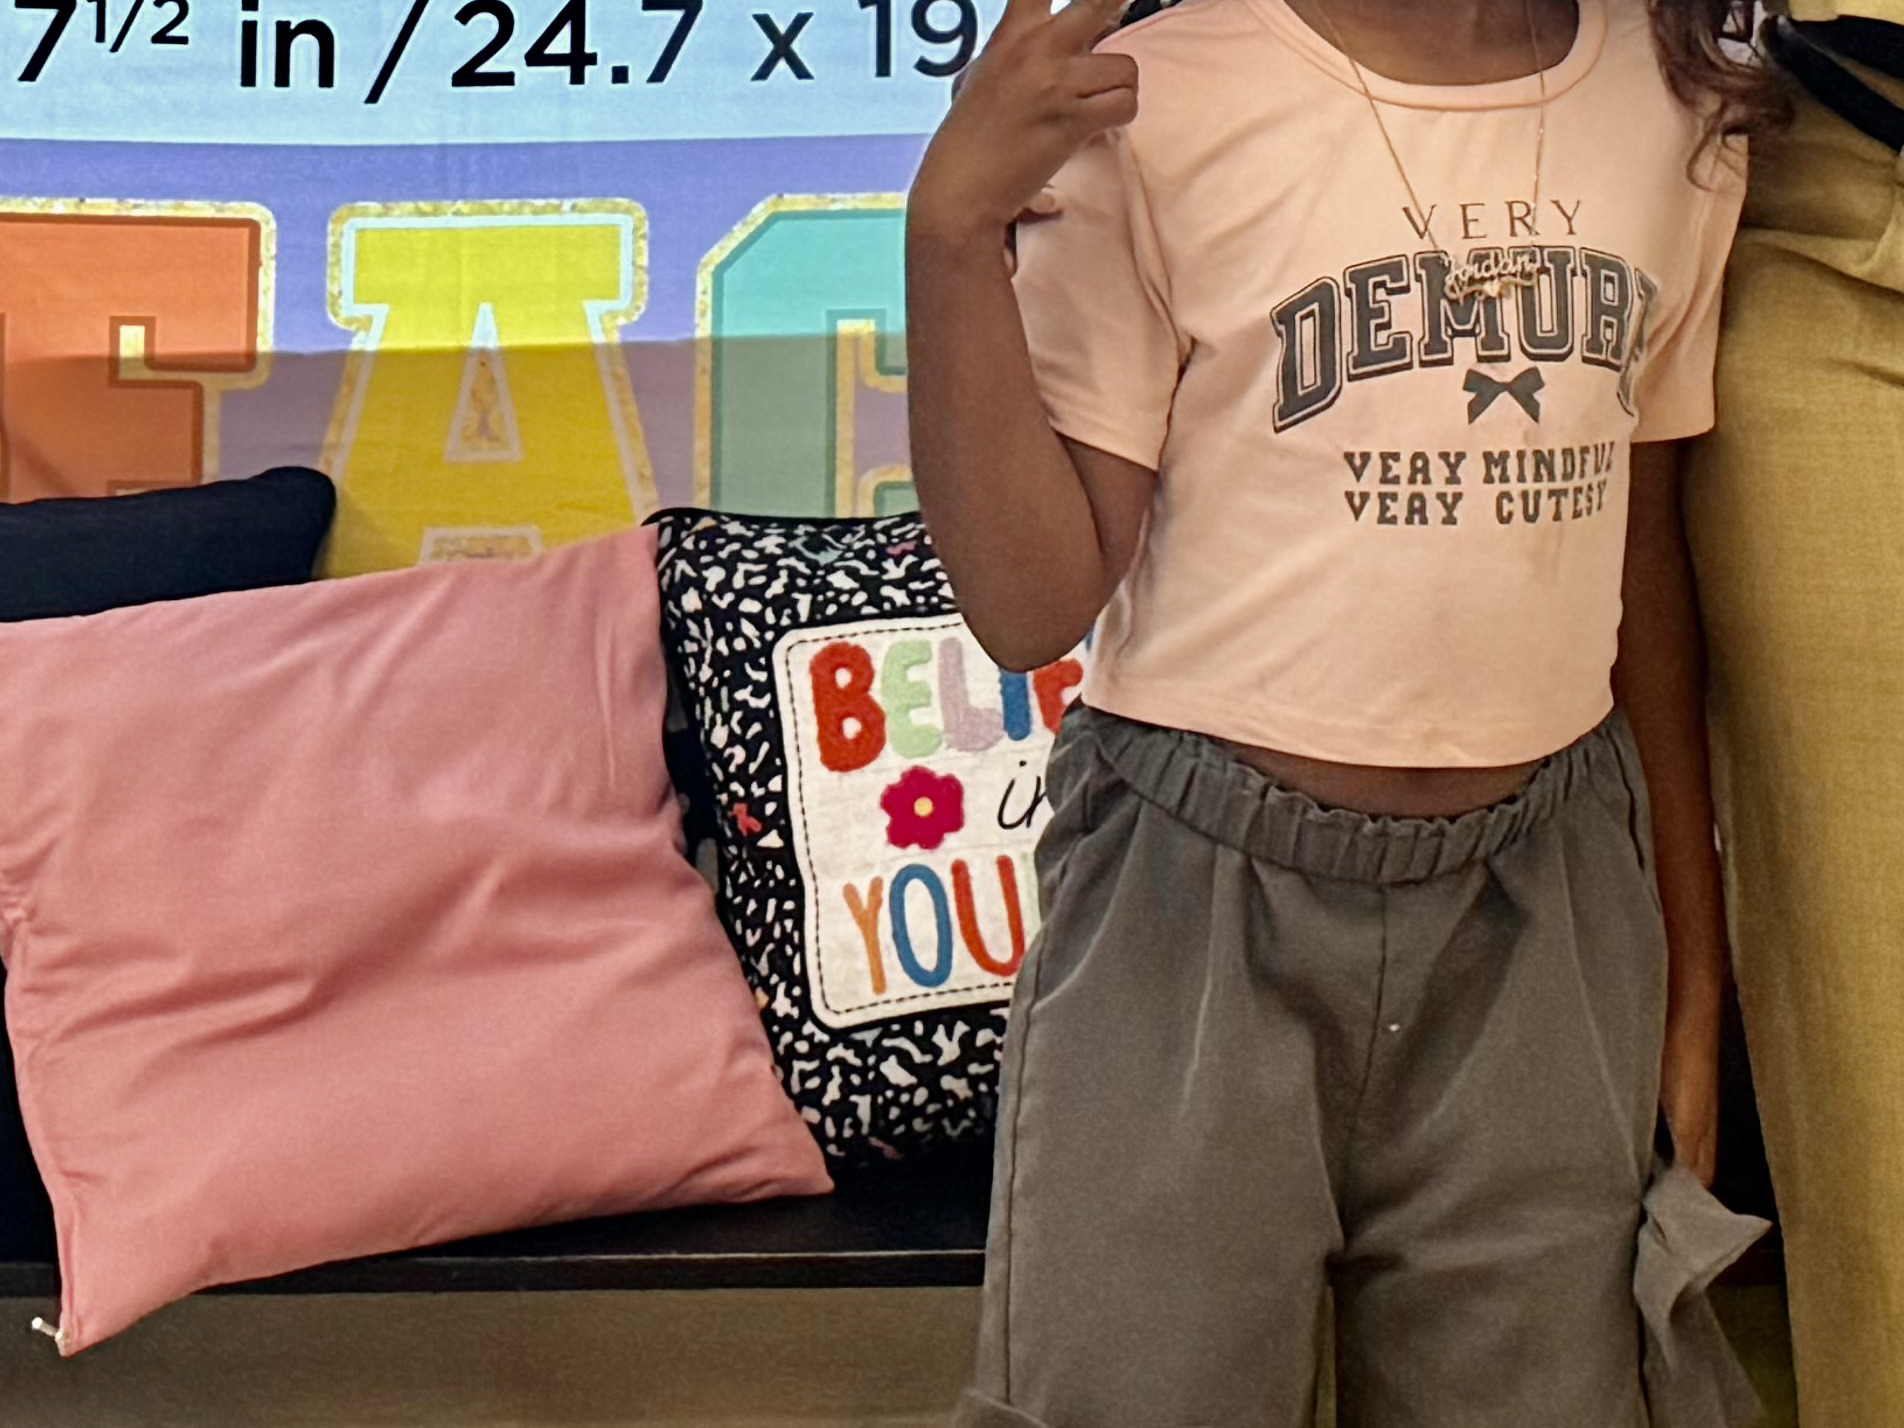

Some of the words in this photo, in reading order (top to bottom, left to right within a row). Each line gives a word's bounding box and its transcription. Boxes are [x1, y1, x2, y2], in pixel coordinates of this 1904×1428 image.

[751, 12, 814, 81] x
[1403, 199, 1581, 240] VERY
[1344, 450, 1467, 485] VERY
[1344, 490, 1464, 525] VERY
[1495, 480, 1608, 525] CUTESY
[842, 852, 1041, 995] YOU
